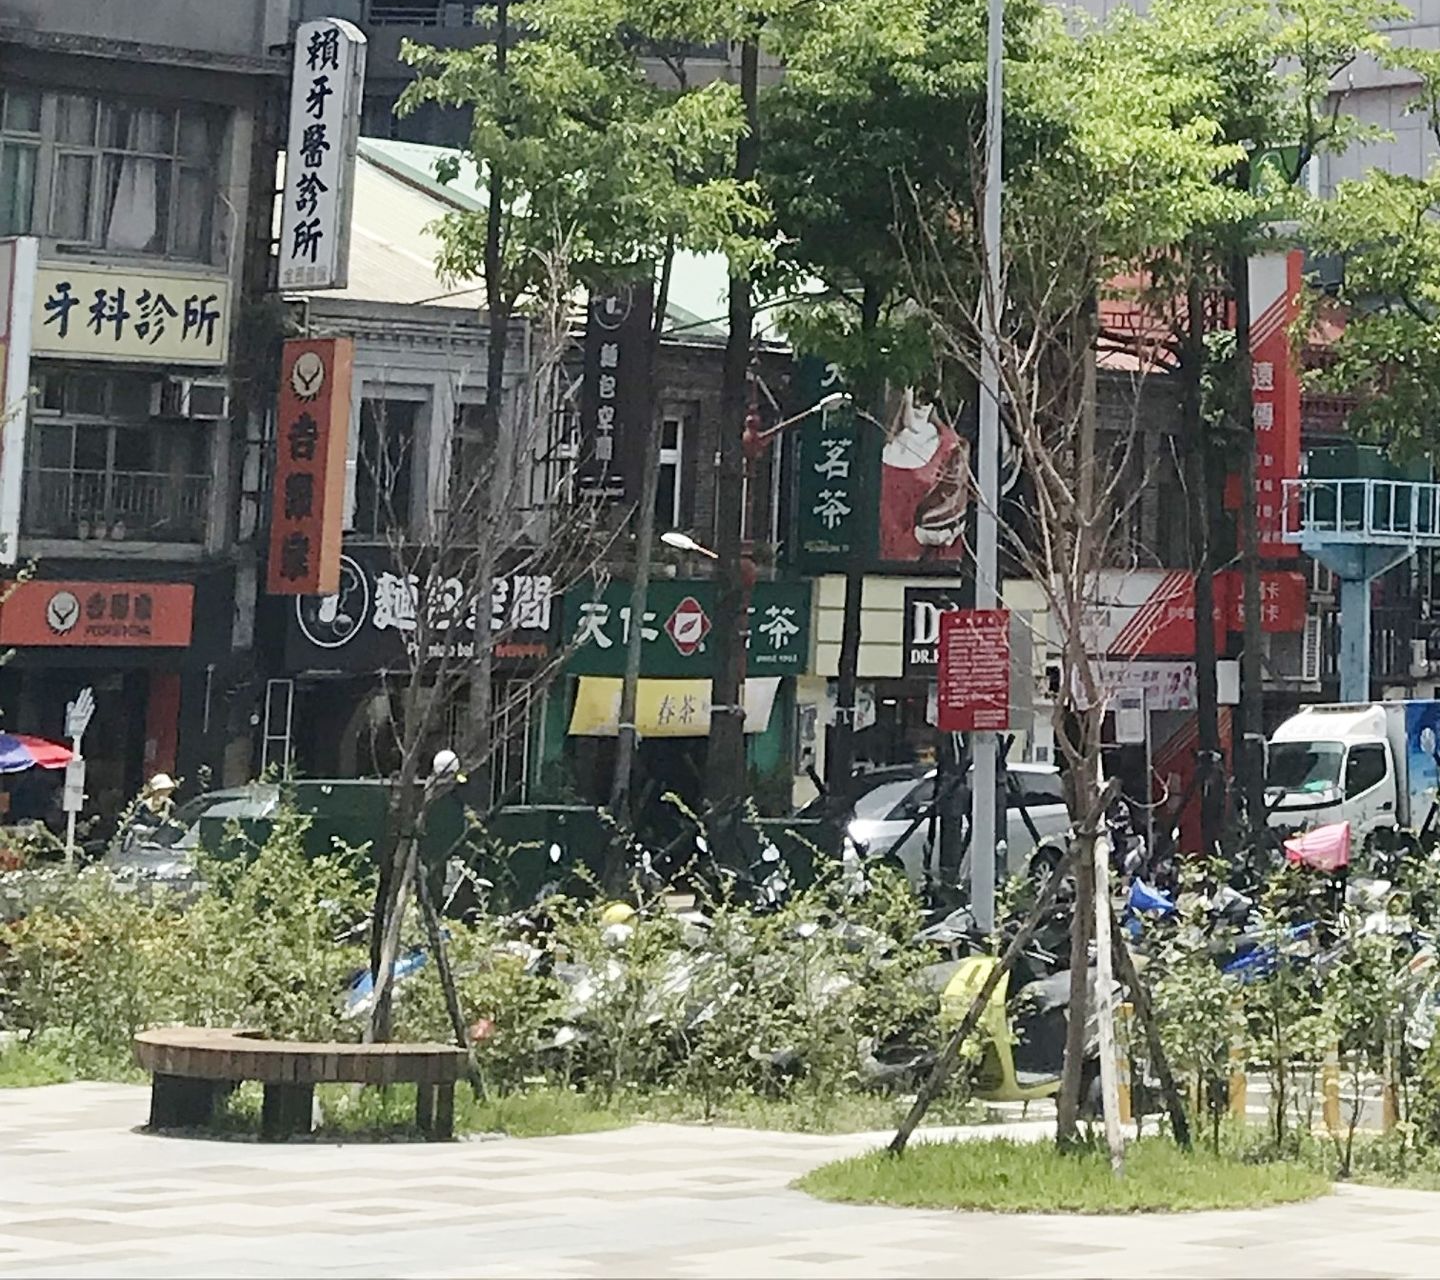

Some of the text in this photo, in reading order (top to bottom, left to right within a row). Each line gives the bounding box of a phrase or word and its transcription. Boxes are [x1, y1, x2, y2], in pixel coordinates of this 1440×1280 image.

[291, 29, 340, 263] 賴牙醫診所
[43, 281, 221, 347] 牙科診所
